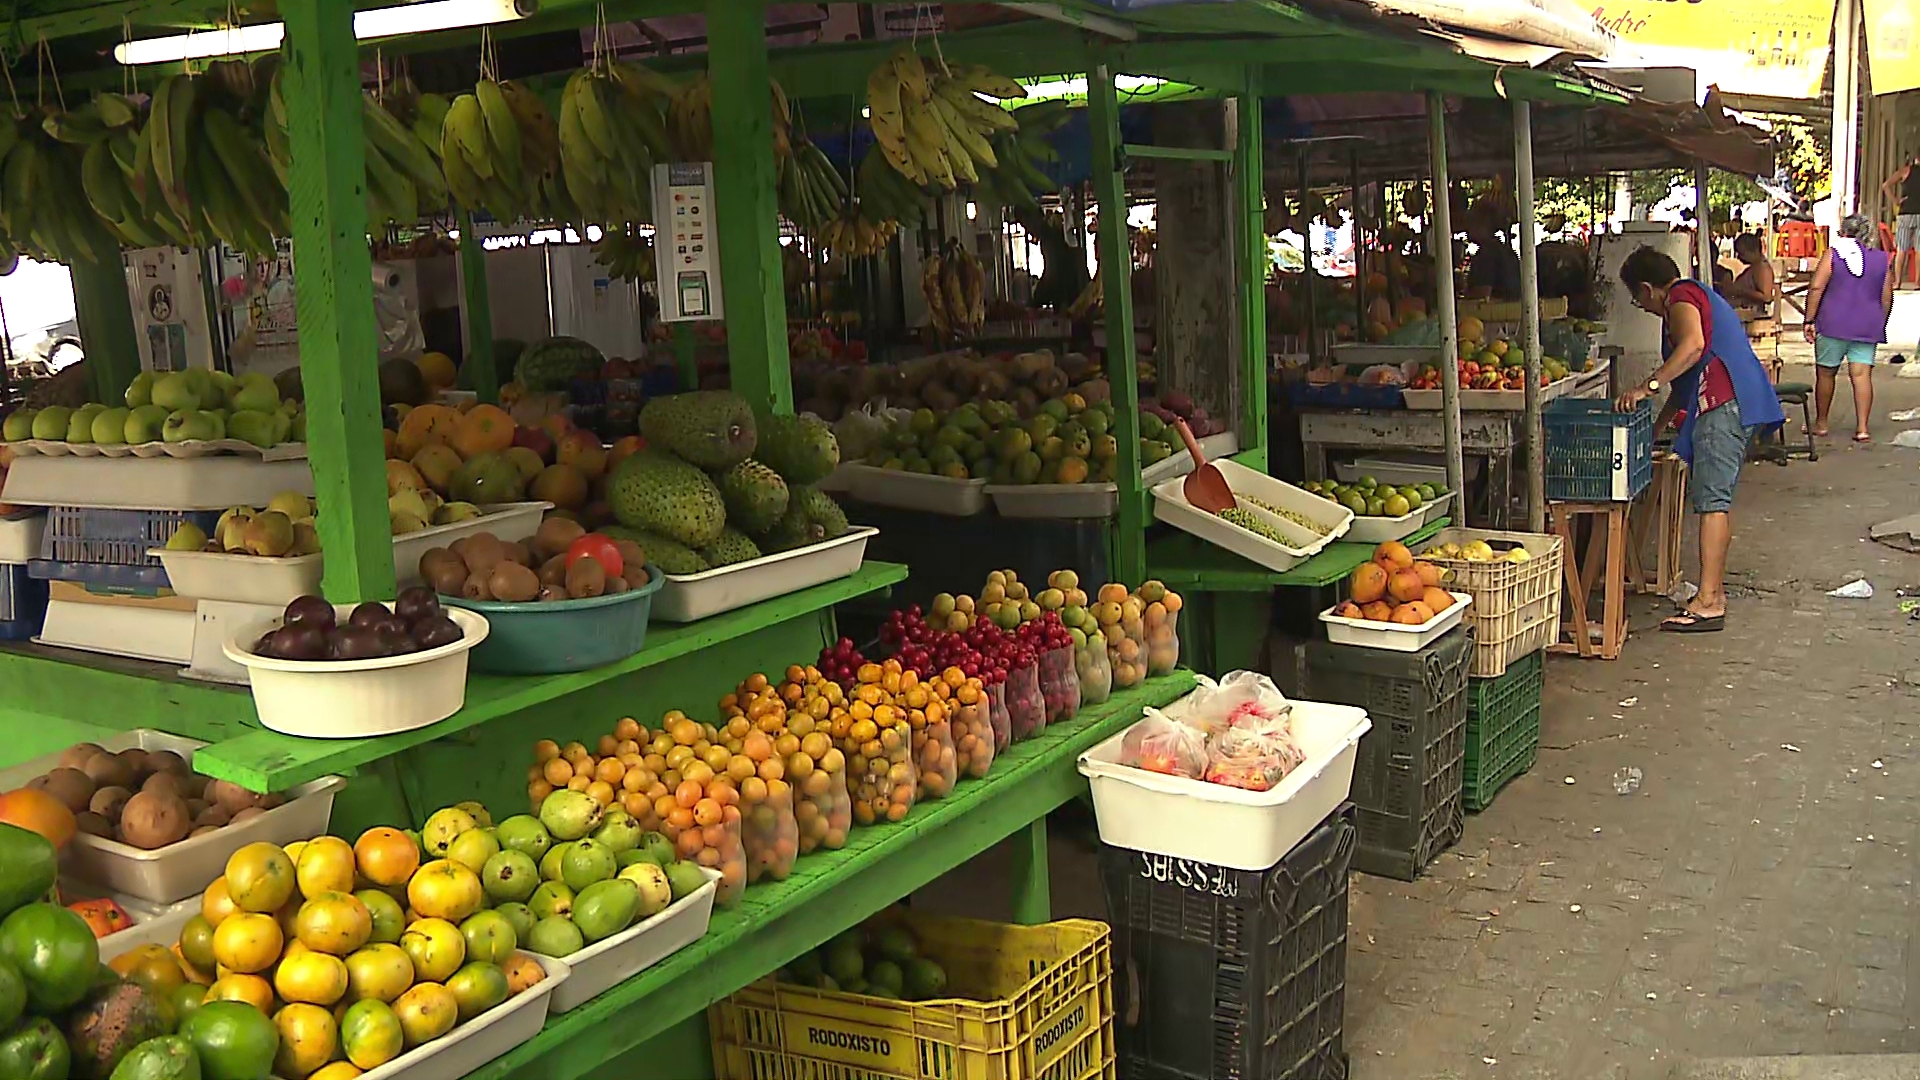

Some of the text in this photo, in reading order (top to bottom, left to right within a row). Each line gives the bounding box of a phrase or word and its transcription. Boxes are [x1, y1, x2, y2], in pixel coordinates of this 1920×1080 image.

[1613, 452, 1623, 471] 8
[808, 1027, 891, 1056] RODOXISTO
[1035, 1005, 1085, 1055] RODOXISTO
